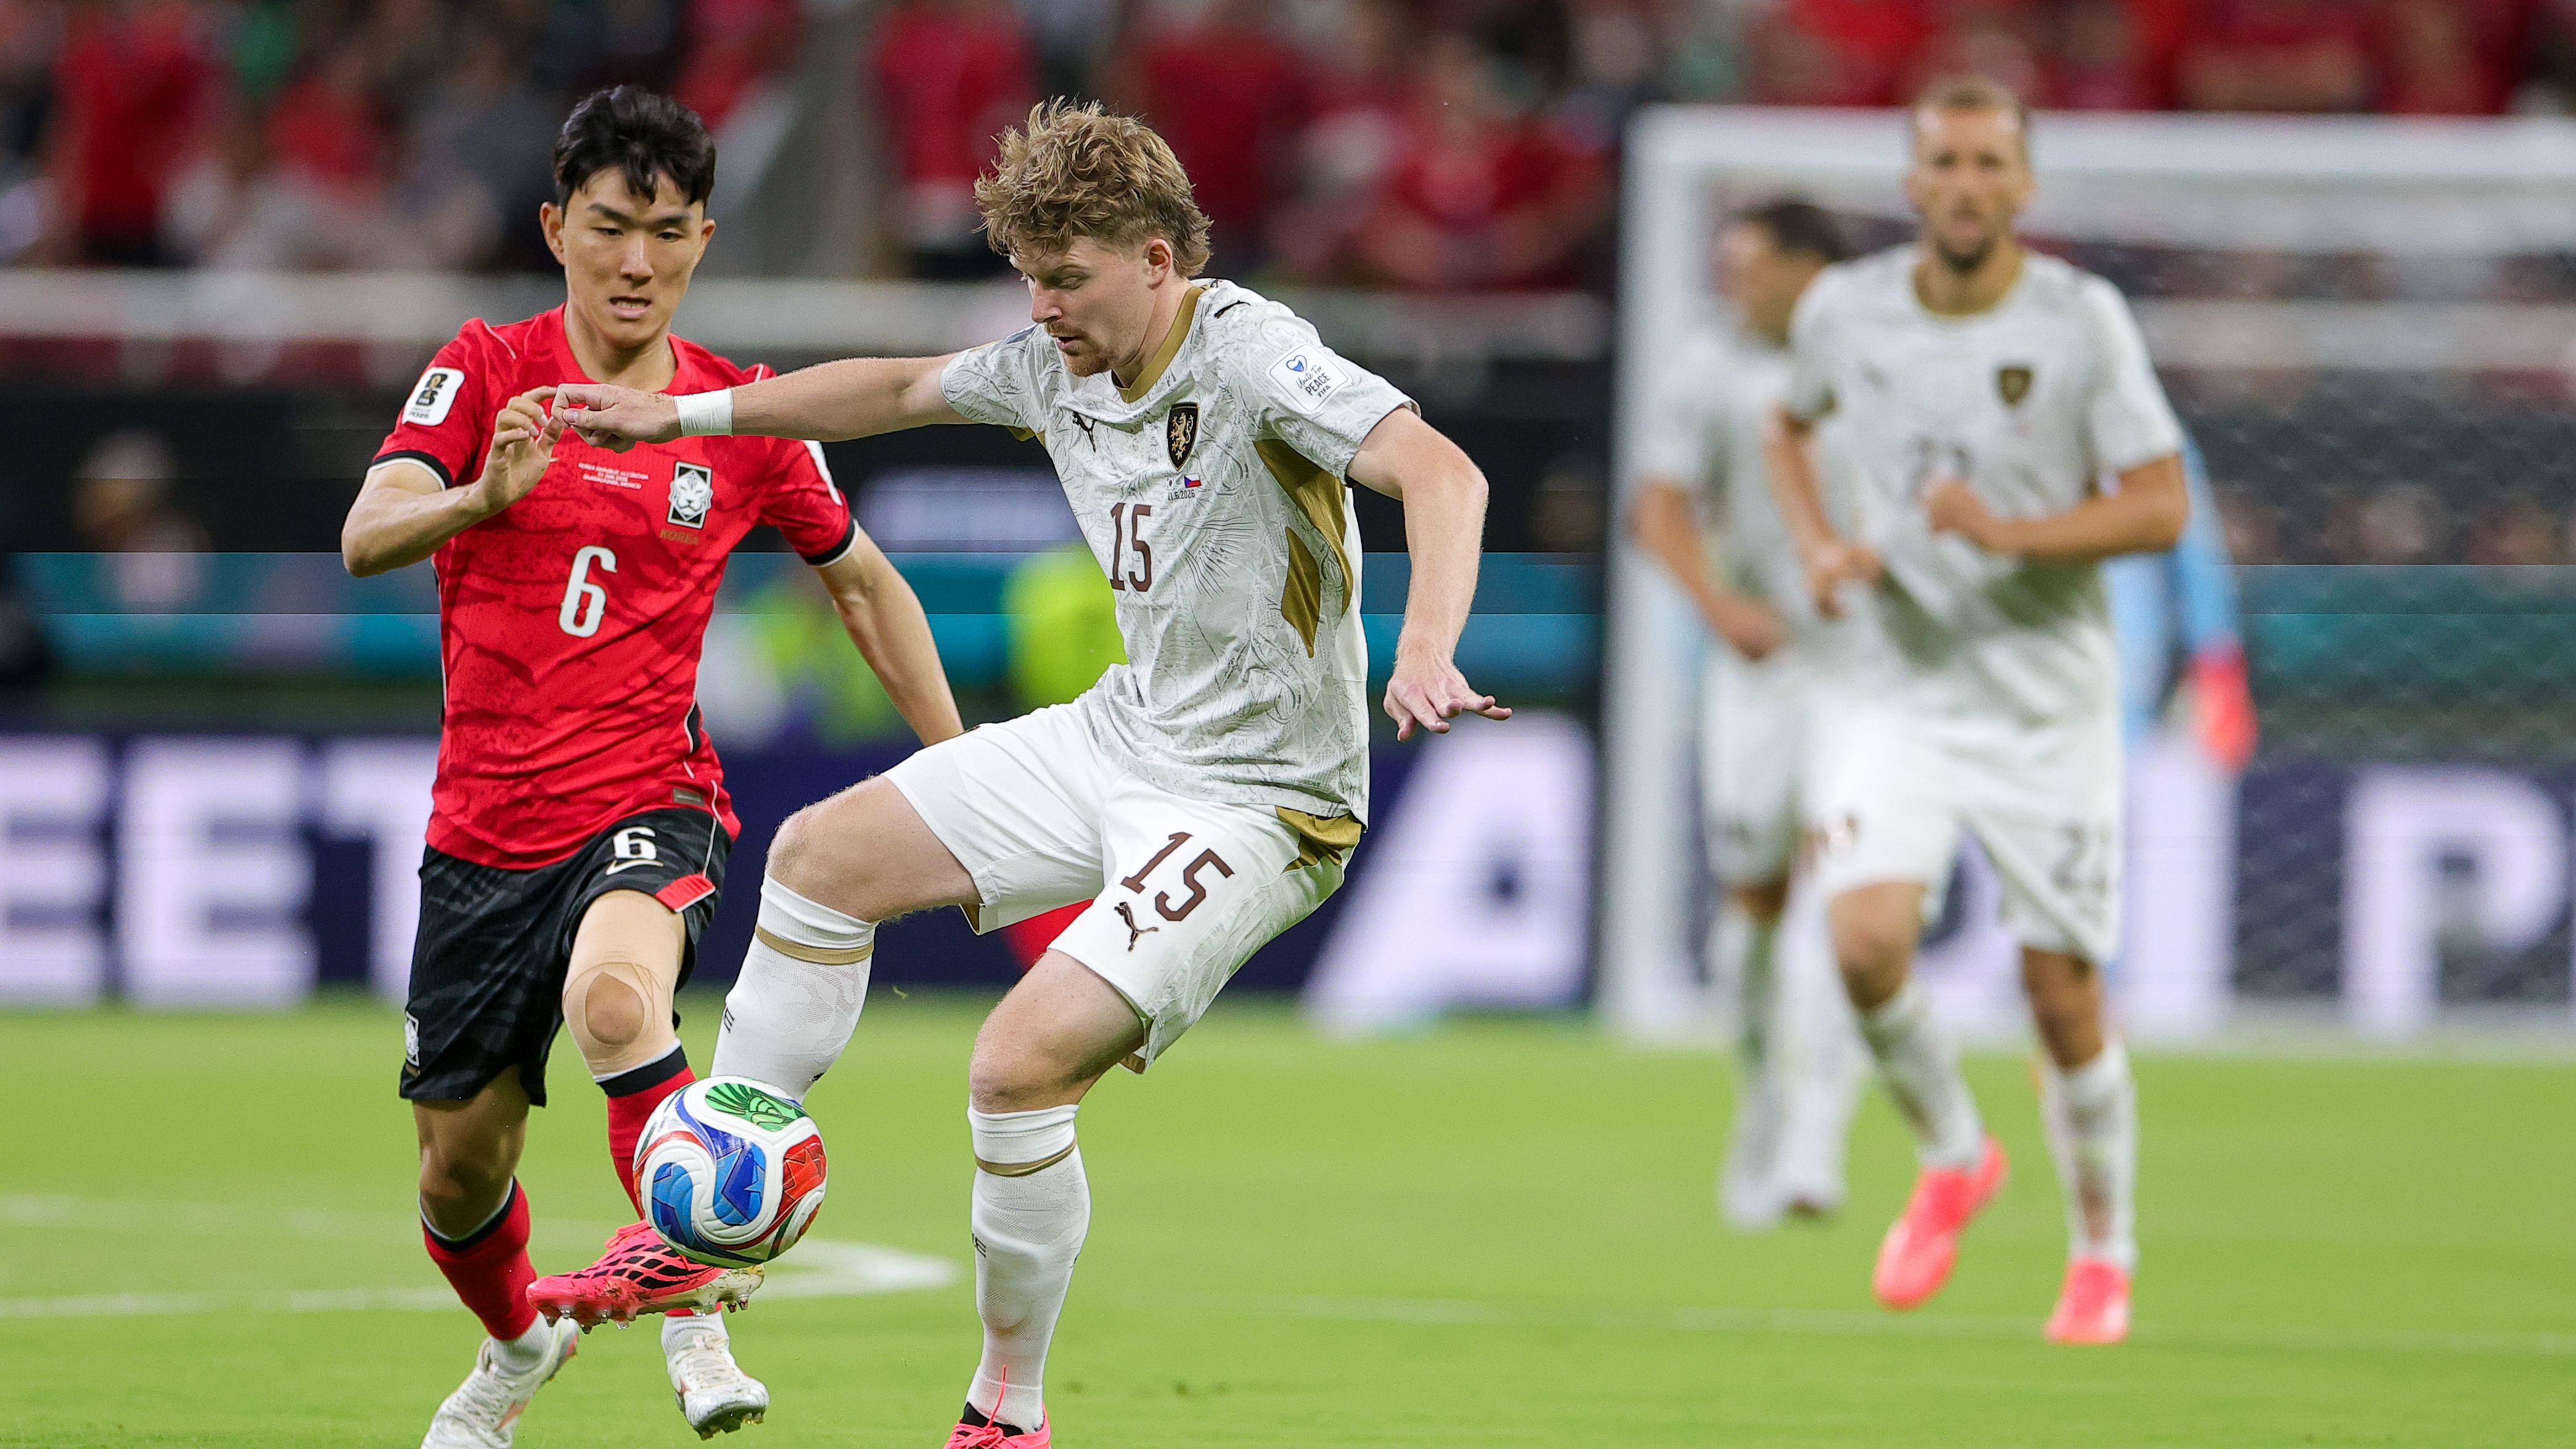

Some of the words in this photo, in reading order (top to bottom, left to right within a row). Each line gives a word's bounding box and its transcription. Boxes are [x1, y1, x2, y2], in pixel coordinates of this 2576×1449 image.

[1305, 372, 1331, 396] PEACE
[1318, 385, 1331, 397] FIFA
[1168, 489, 1195, 501] 11.6.2026
[1110, 502, 1152, 592] 15
[558, 544, 618, 638] 6
[613, 826, 657, 860] 6
[1120, 831, 1236, 922] 15
[971, 1233, 987, 1258] E
